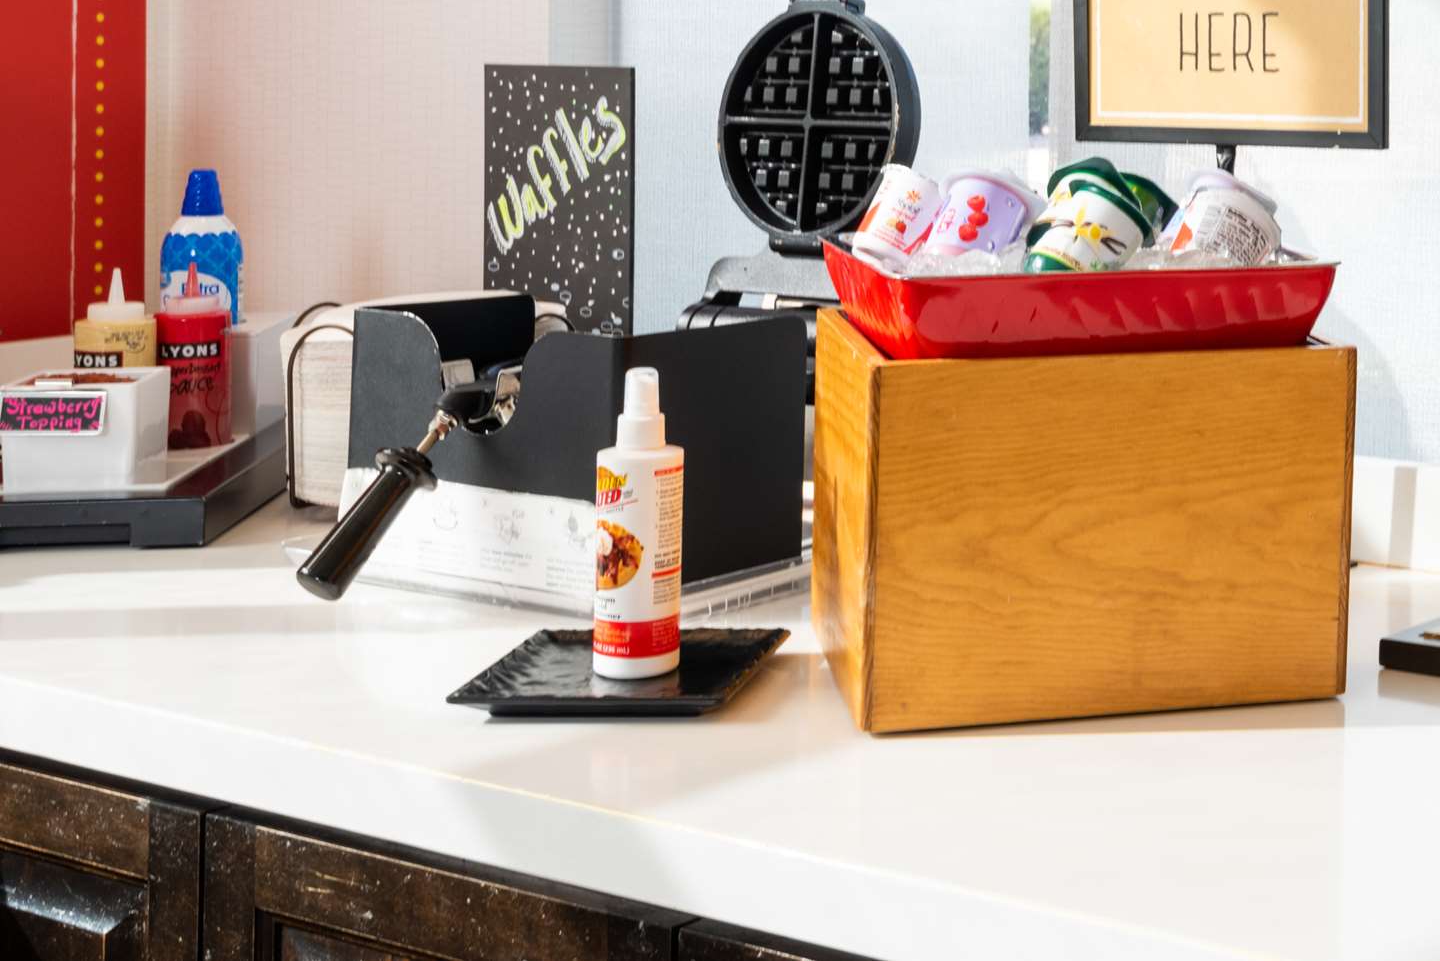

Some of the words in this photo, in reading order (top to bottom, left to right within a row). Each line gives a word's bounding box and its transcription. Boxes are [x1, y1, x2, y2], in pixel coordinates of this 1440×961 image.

[1178, 11, 1280, 74] HERE
[486, 95, 626, 256] Waffles
[161, 342, 218, 359] LYONS
[74, 354, 118, 368] YONS
[4, 396, 102, 418] Strawberry
[16, 415, 82, 434] Topping
